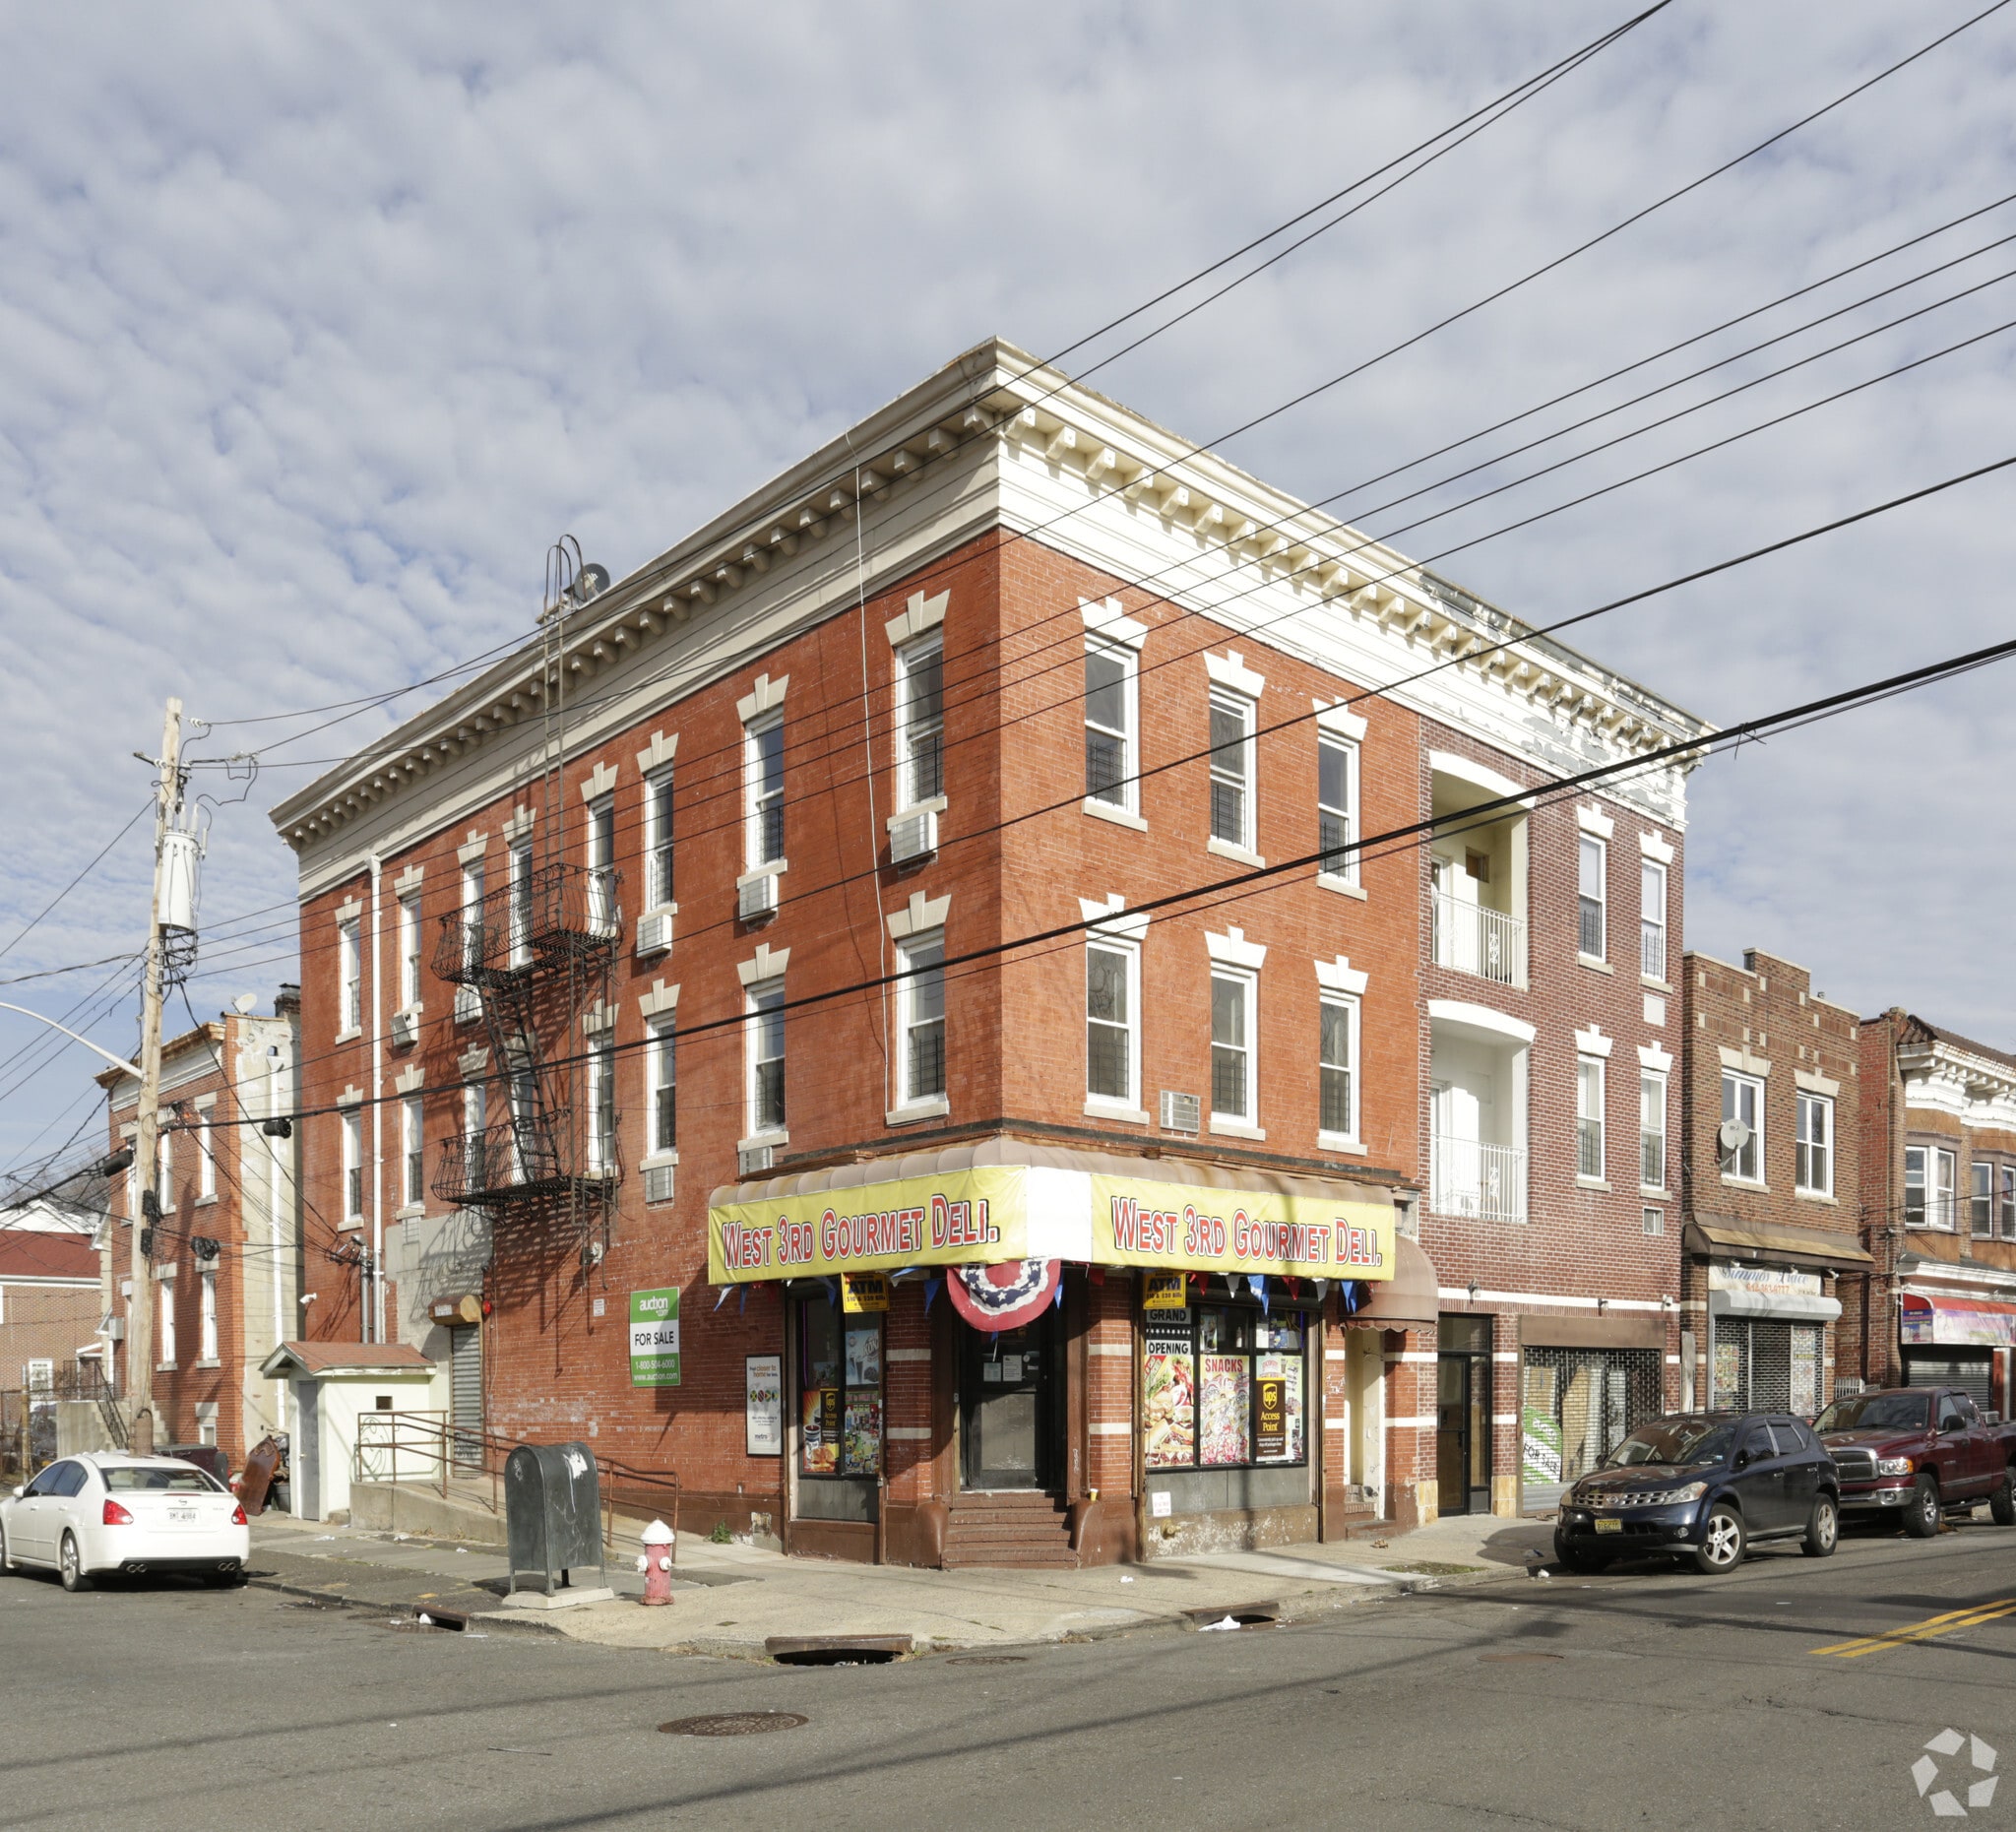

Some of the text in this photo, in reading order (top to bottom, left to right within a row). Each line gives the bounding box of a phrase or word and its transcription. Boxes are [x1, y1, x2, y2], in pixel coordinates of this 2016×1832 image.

[849, 1280, 884, 1294] ATM
[1148, 1277, 1181, 1291] ATM
[639, 1295, 668, 1311] auction
[1150, 1308, 1187, 1321] GRAND
[634, 1331, 674, 1346] FOR SALE
[1148, 1342, 1189, 1355] OPENING
[1205, 1358, 1243, 1372] SNACKS
[1265, 1392, 1277, 1406] ups
[1261, 1412, 1280, 1421] Access
[1263, 1422, 1279, 1431] Point
